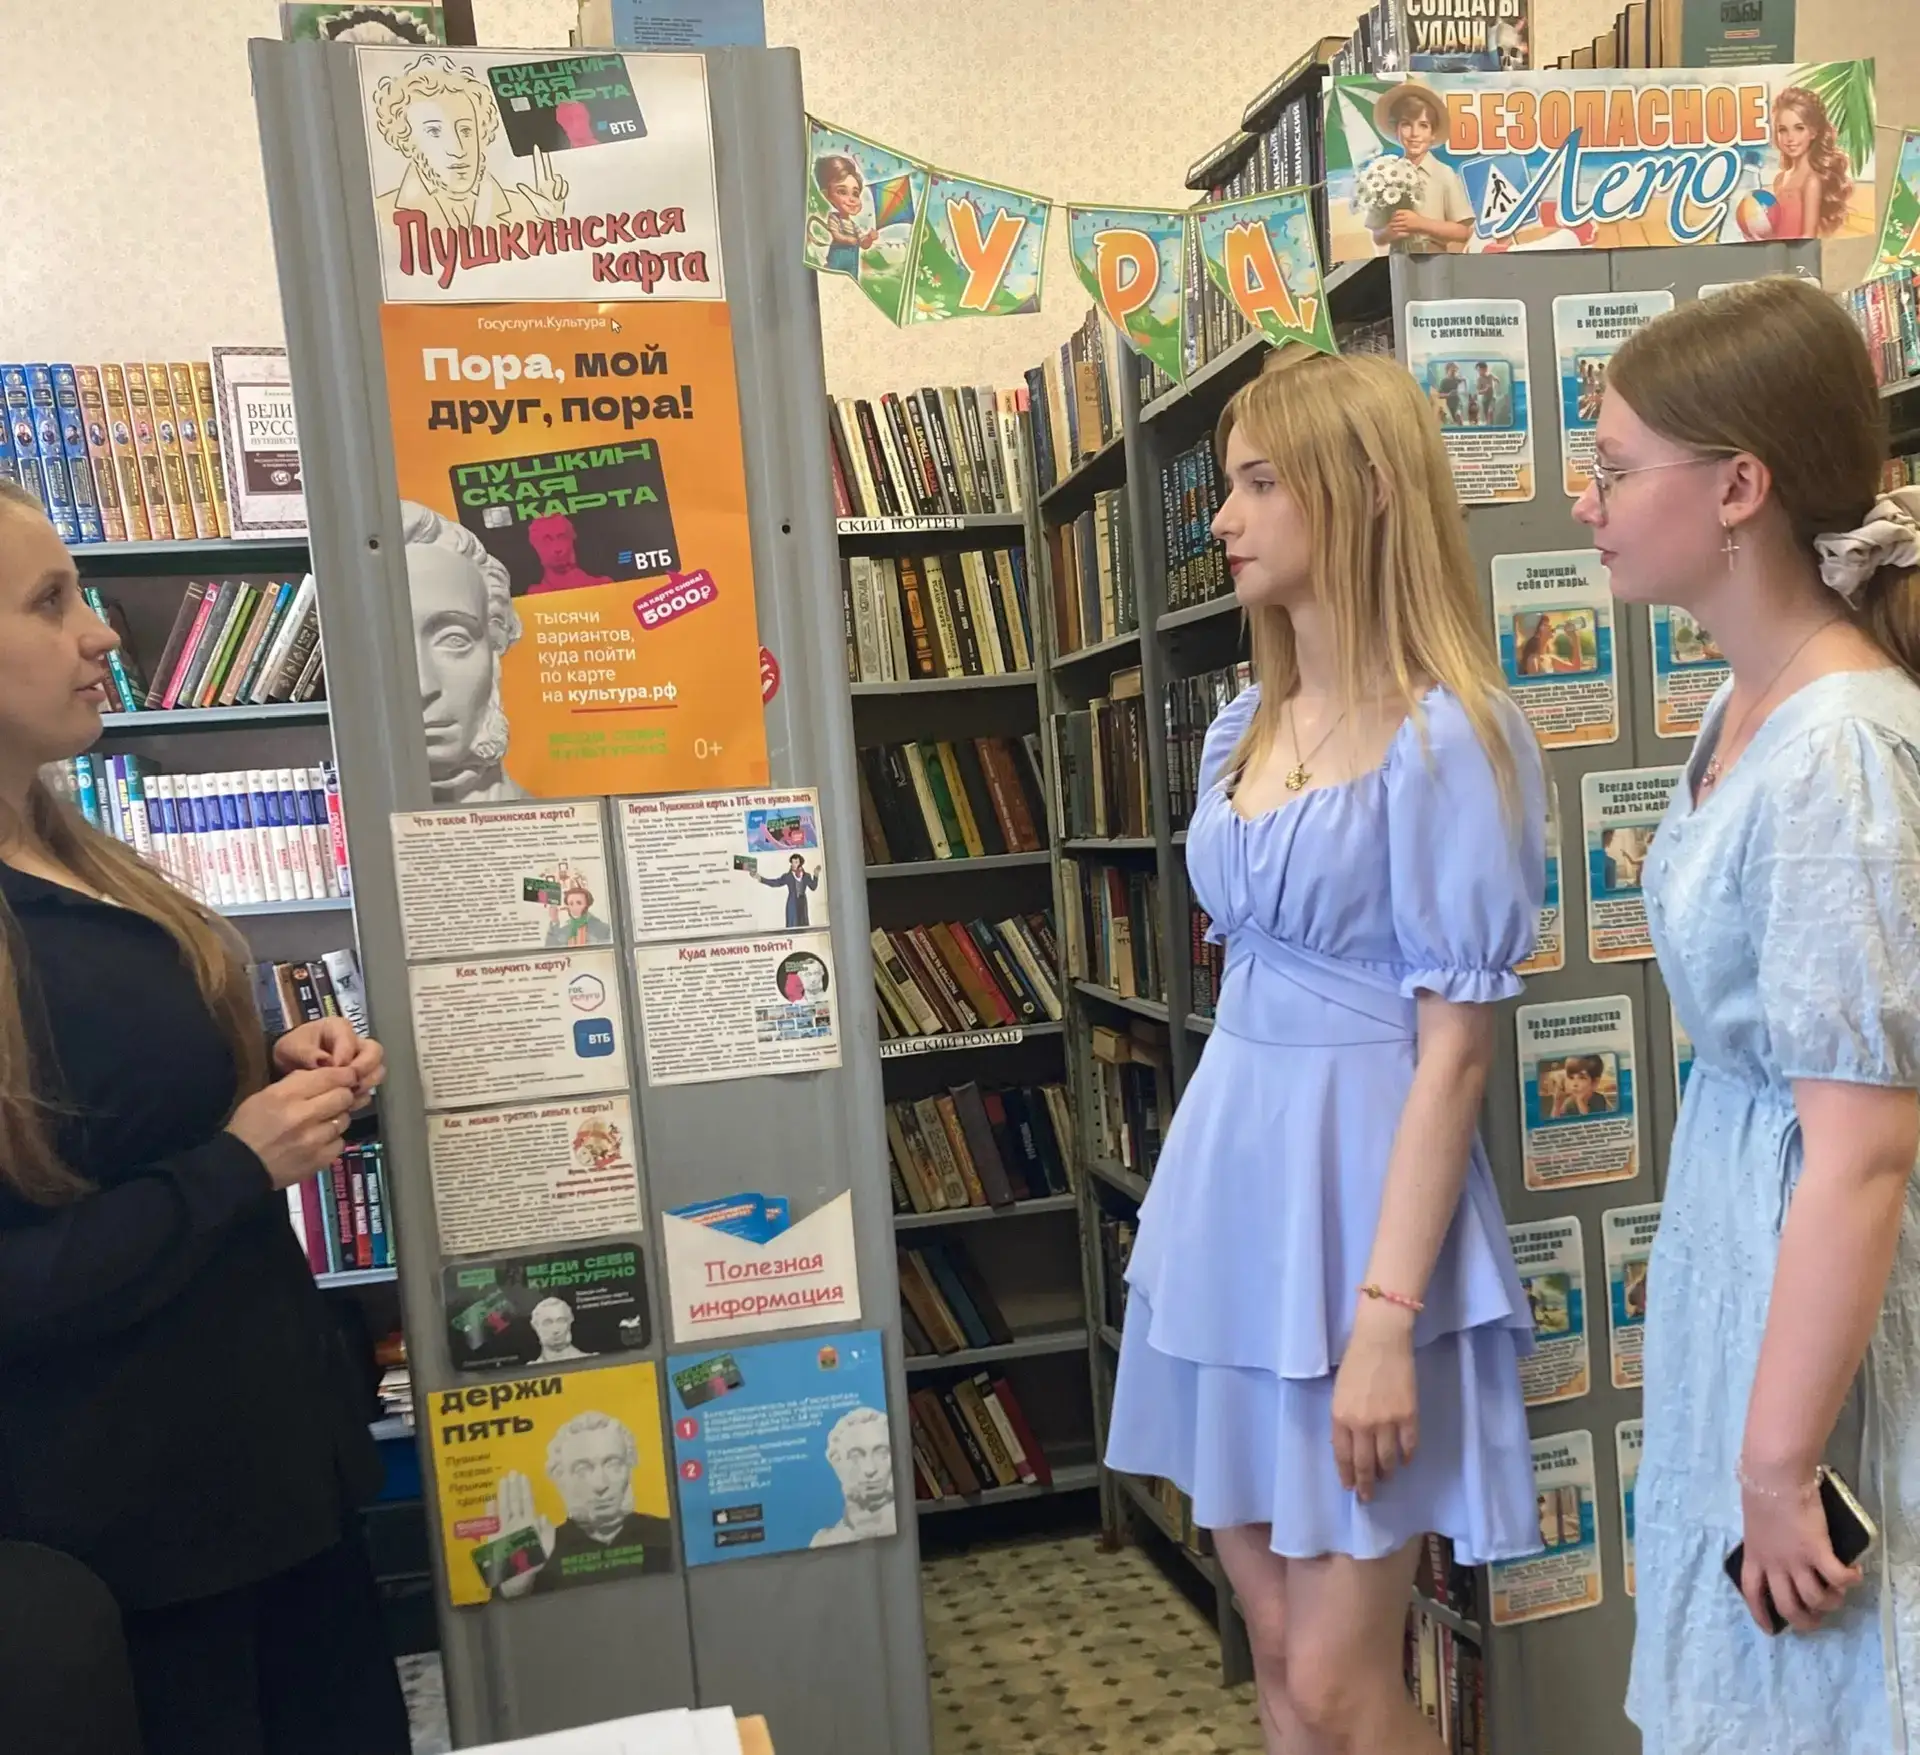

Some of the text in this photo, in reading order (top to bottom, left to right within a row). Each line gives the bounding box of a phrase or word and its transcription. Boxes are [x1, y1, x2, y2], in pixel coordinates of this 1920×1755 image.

[1414, 20, 1487, 52] УДАЧИ
[491, 53, 623, 82] ПУШКИН
[497, 77, 578, 100] СКАЯ
[534, 84, 631, 108] КАРТА
[609, 119, 637, 136] ВТБ
[1445, 84, 1768, 153] БЕЗОПАСНОЕ
[1496, 126, 1739, 239] Лето
[394, 206, 685, 289] Пушкинская
[592, 248, 709, 294] карта
[477, 316, 607, 332] Госуслуги.Культура
[1413, 314, 1519, 327] Осторожно общайся
[1439, 328, 1505, 339] животными.
[422, 343, 668, 390] Пора, мой
[247, 403, 293, 419] ВЕЛИ
[427, 385, 694, 431] друг, пора!
[248, 420, 294, 436] РУСС
[914, 425, 931, 460] ТРАМП
[456, 442, 652, 487] ПУШКИН
[462, 475, 579, 507] СКАЯ
[516, 485, 658, 521] КАРТА
[838, 516, 961, 532] СКИЙ ПОРТРЕТ
[634, 549, 672, 570] ВТБ
[1517, 576, 1589, 590] себя от жары.
[1526, 565, 1577, 579] Защищай
[535, 611, 600, 626] тысячи
[537, 628, 635, 646] вариантов,
[538, 645, 636, 666] куда пойти
[540, 666, 616, 684] по карте
[542, 681, 677, 705] на культура.рф
[693, 737, 723, 759] 0+
[1599, 778, 1676, 793] Всегда сообща
[1613, 789, 1669, 803] взрослым,
[706, 797, 729, 811] карты
[1602, 804, 1626, 815] куда
[1629, 803, 1643, 811] ты
[413, 807, 576, 827] Что такое Пушкинская карта?
[679, 938, 794, 962] Куда можно пойти?
[456, 957, 572, 979] Как получить карту?
[588, 1033, 611, 1044] ВТБ
[961, 1030, 1020, 1047] РОМАН
[443, 1117, 462, 1128] Как
[468, 1114, 500, 1126] можно
[581, 1101, 614, 1113] карты?
[526, 1252, 635, 1276] ВЕДИ СЕБЯ
[705, 1254, 824, 1282] Полезная
[527, 1267, 636, 1289] КУЛЬТУРНО
[689, 1285, 844, 1319] информация
[440, 1377, 563, 1415] держи
[442, 1416, 534, 1446] пять
[684, 1422, 692, 1436] 1
[687, 1463, 696, 1478] 2
